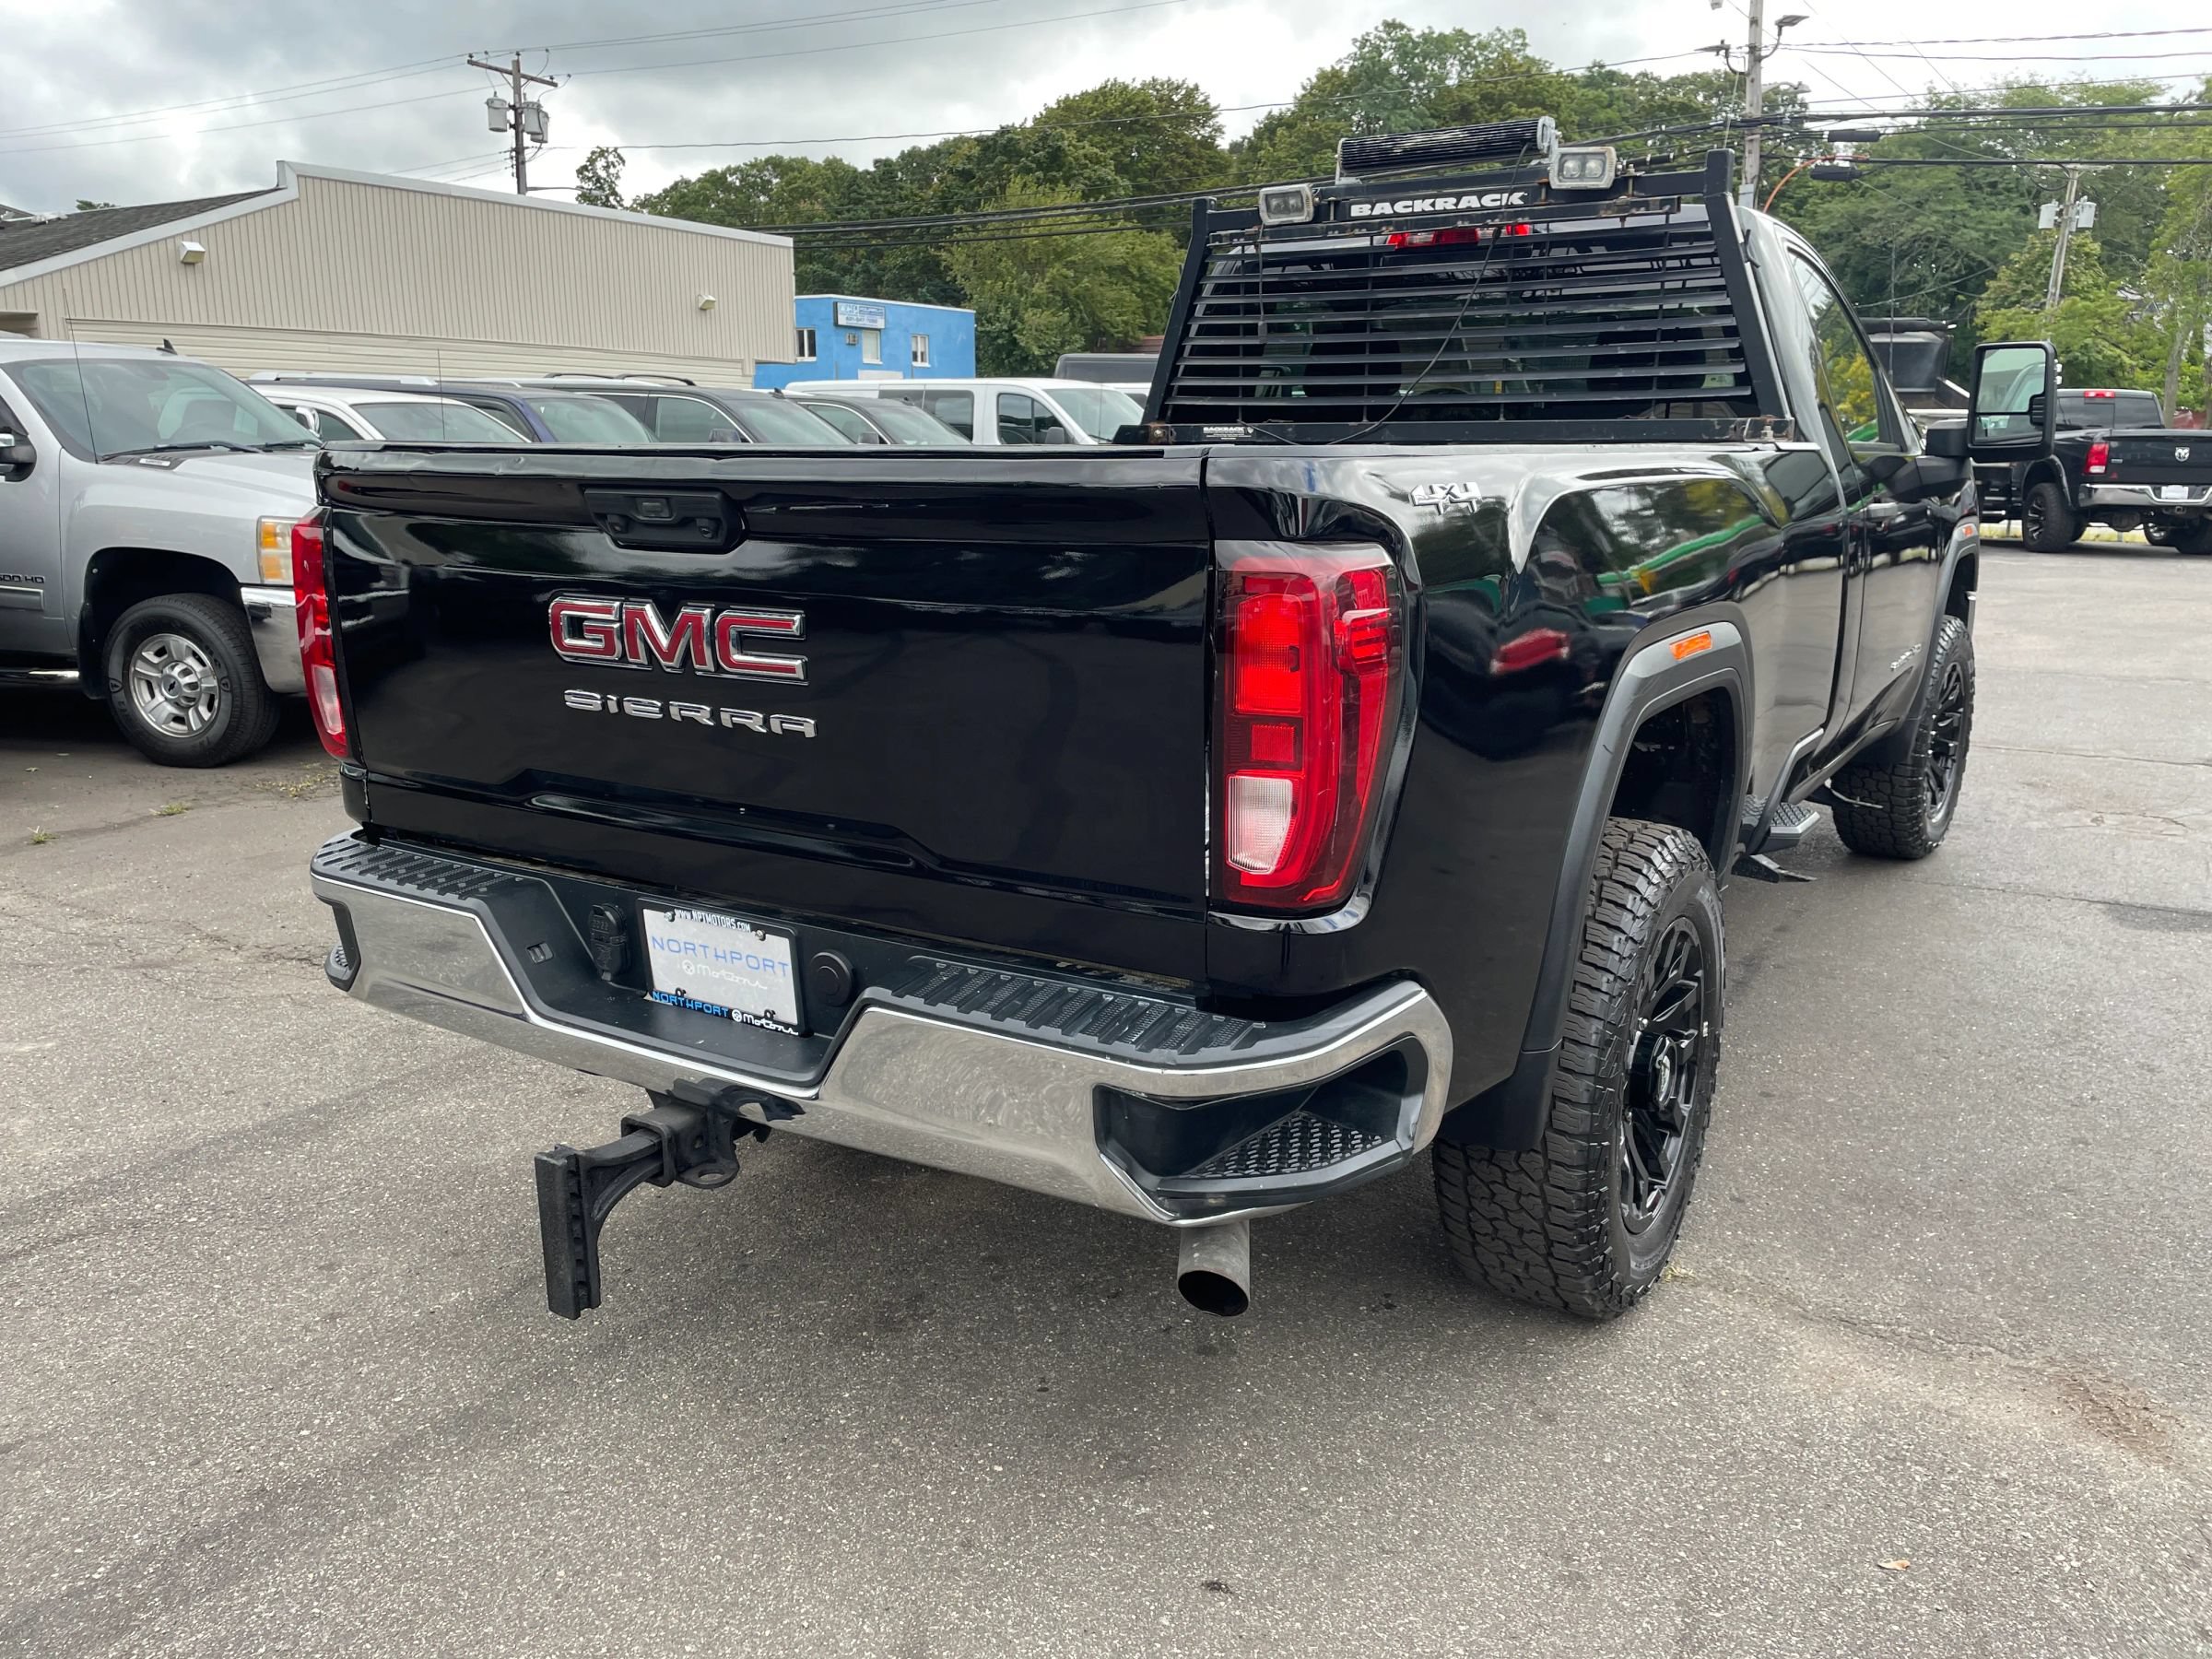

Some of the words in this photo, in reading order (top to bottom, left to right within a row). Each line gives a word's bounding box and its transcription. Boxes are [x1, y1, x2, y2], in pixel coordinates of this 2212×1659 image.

[1350, 192, 1525, 218] BACKRACK
[548, 594, 809, 686] GMC
[563, 689, 818, 738] SIERRA
[651, 935, 789, 978] NORTHPORT
[652, 991, 729, 1018] NORTHPORT
